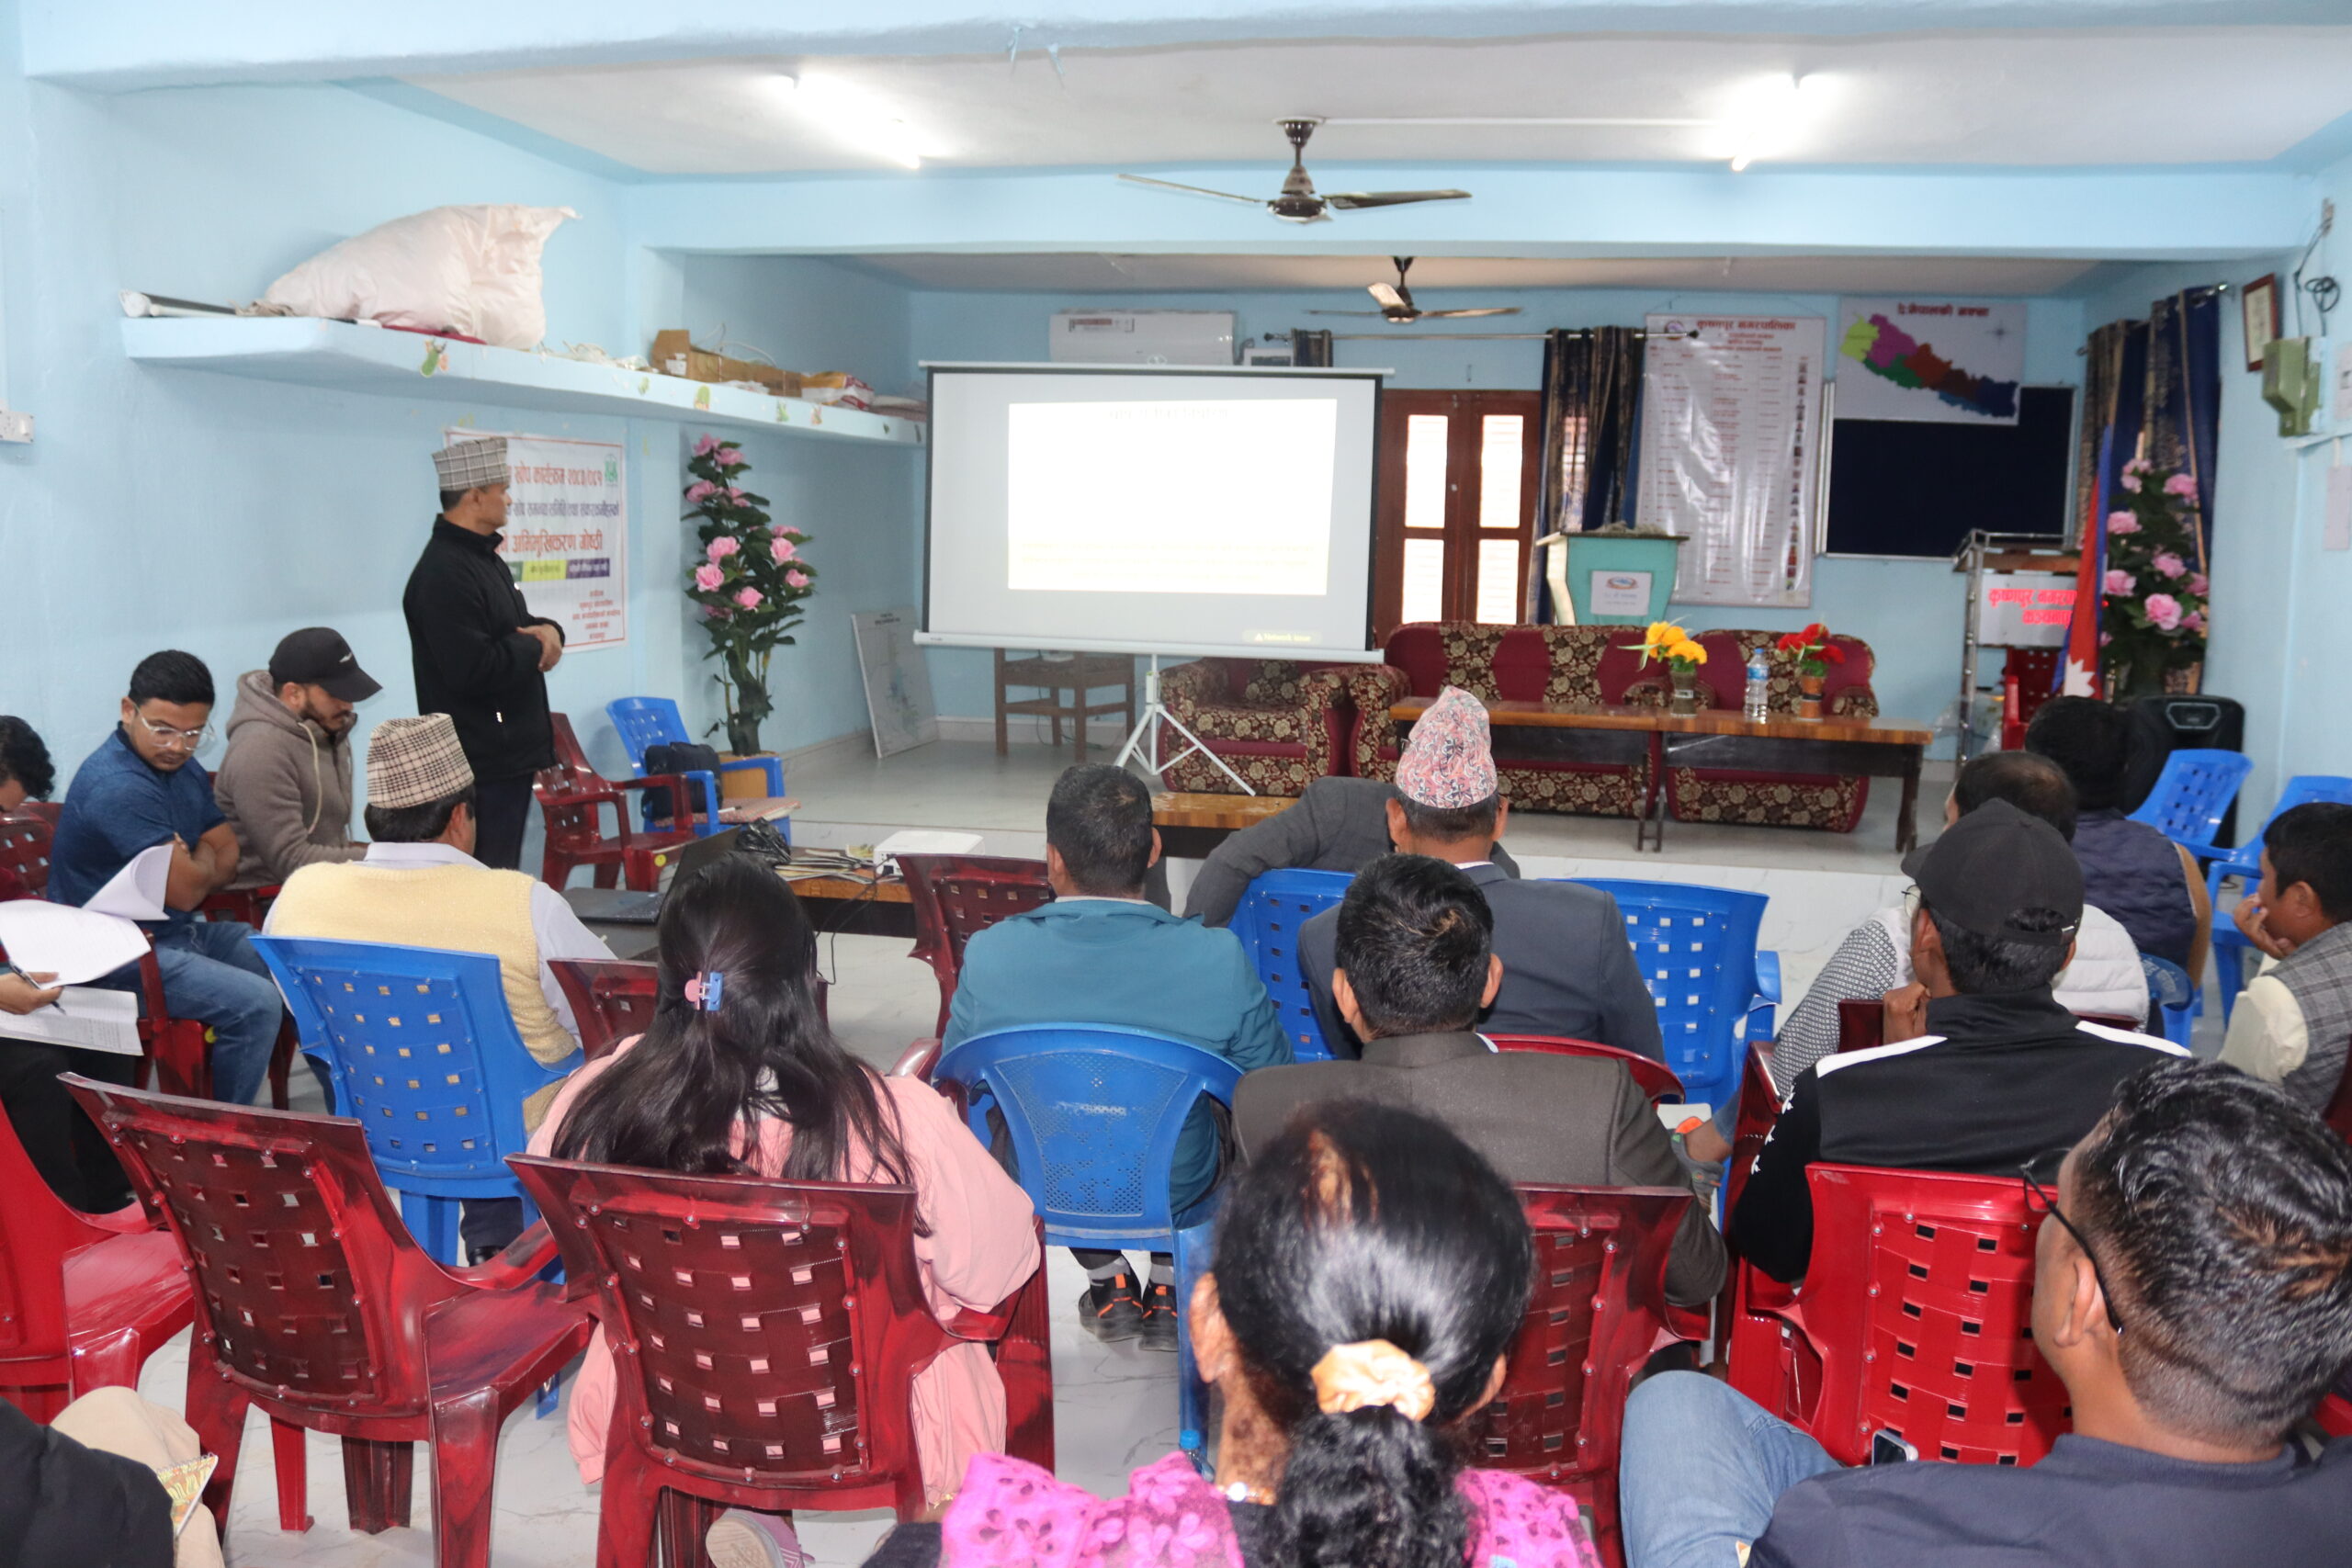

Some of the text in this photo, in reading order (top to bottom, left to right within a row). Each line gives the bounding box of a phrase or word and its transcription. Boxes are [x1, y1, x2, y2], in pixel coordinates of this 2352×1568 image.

[1737, 320, 1796, 332] नगरपालिका
[1988, 589, 2034, 608] कृष्णपुर
[2022, 609, 2072, 629] कञ्चनपु
